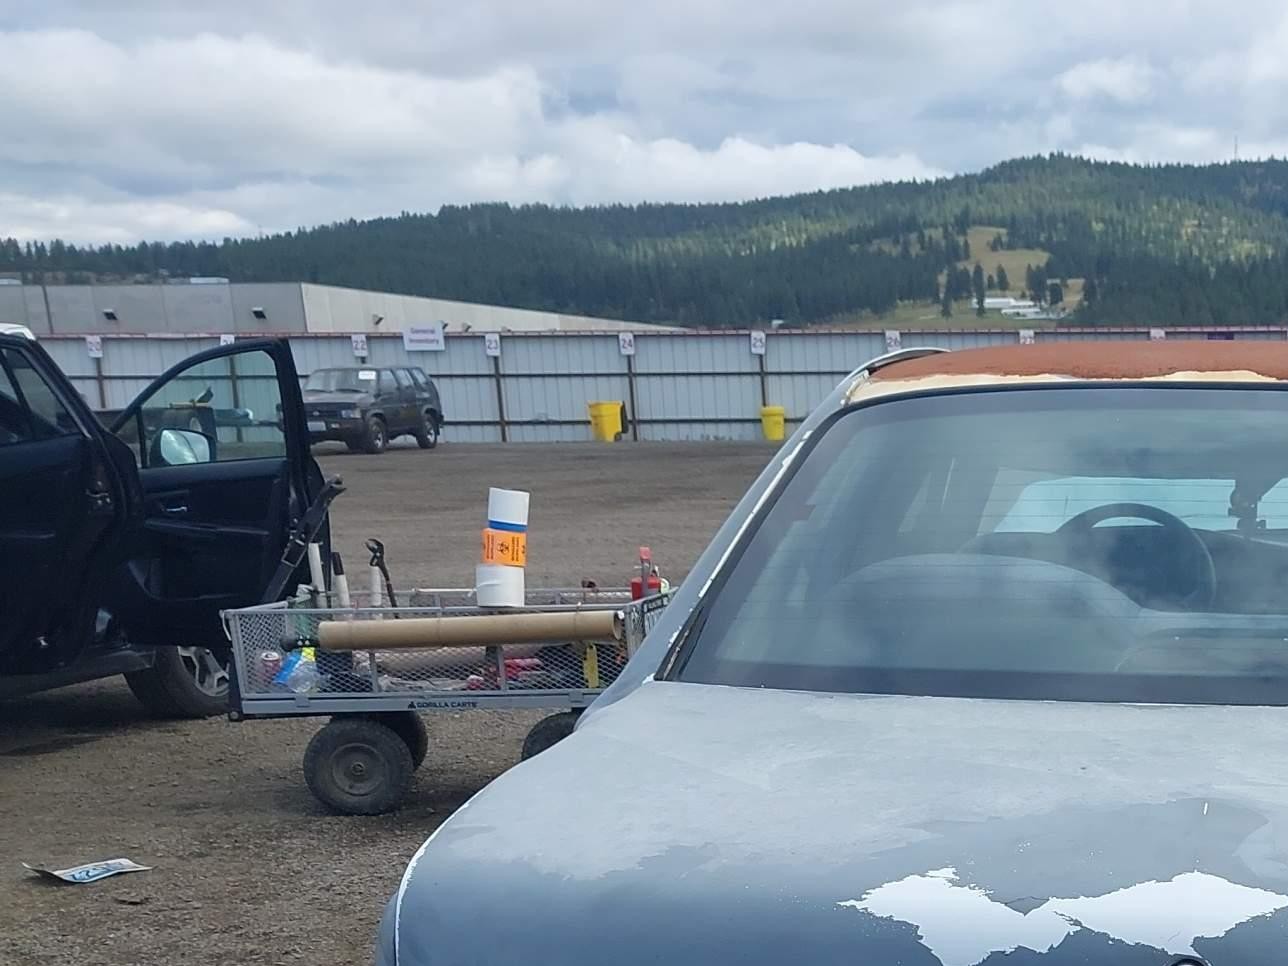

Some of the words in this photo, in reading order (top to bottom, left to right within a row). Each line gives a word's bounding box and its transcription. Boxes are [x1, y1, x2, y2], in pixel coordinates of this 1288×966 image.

[353, 339, 366, 351] 22
[487, 338, 499, 350] 23
[621, 337, 633, 349] 24
[416, 701, 449, 709] GORILLA
